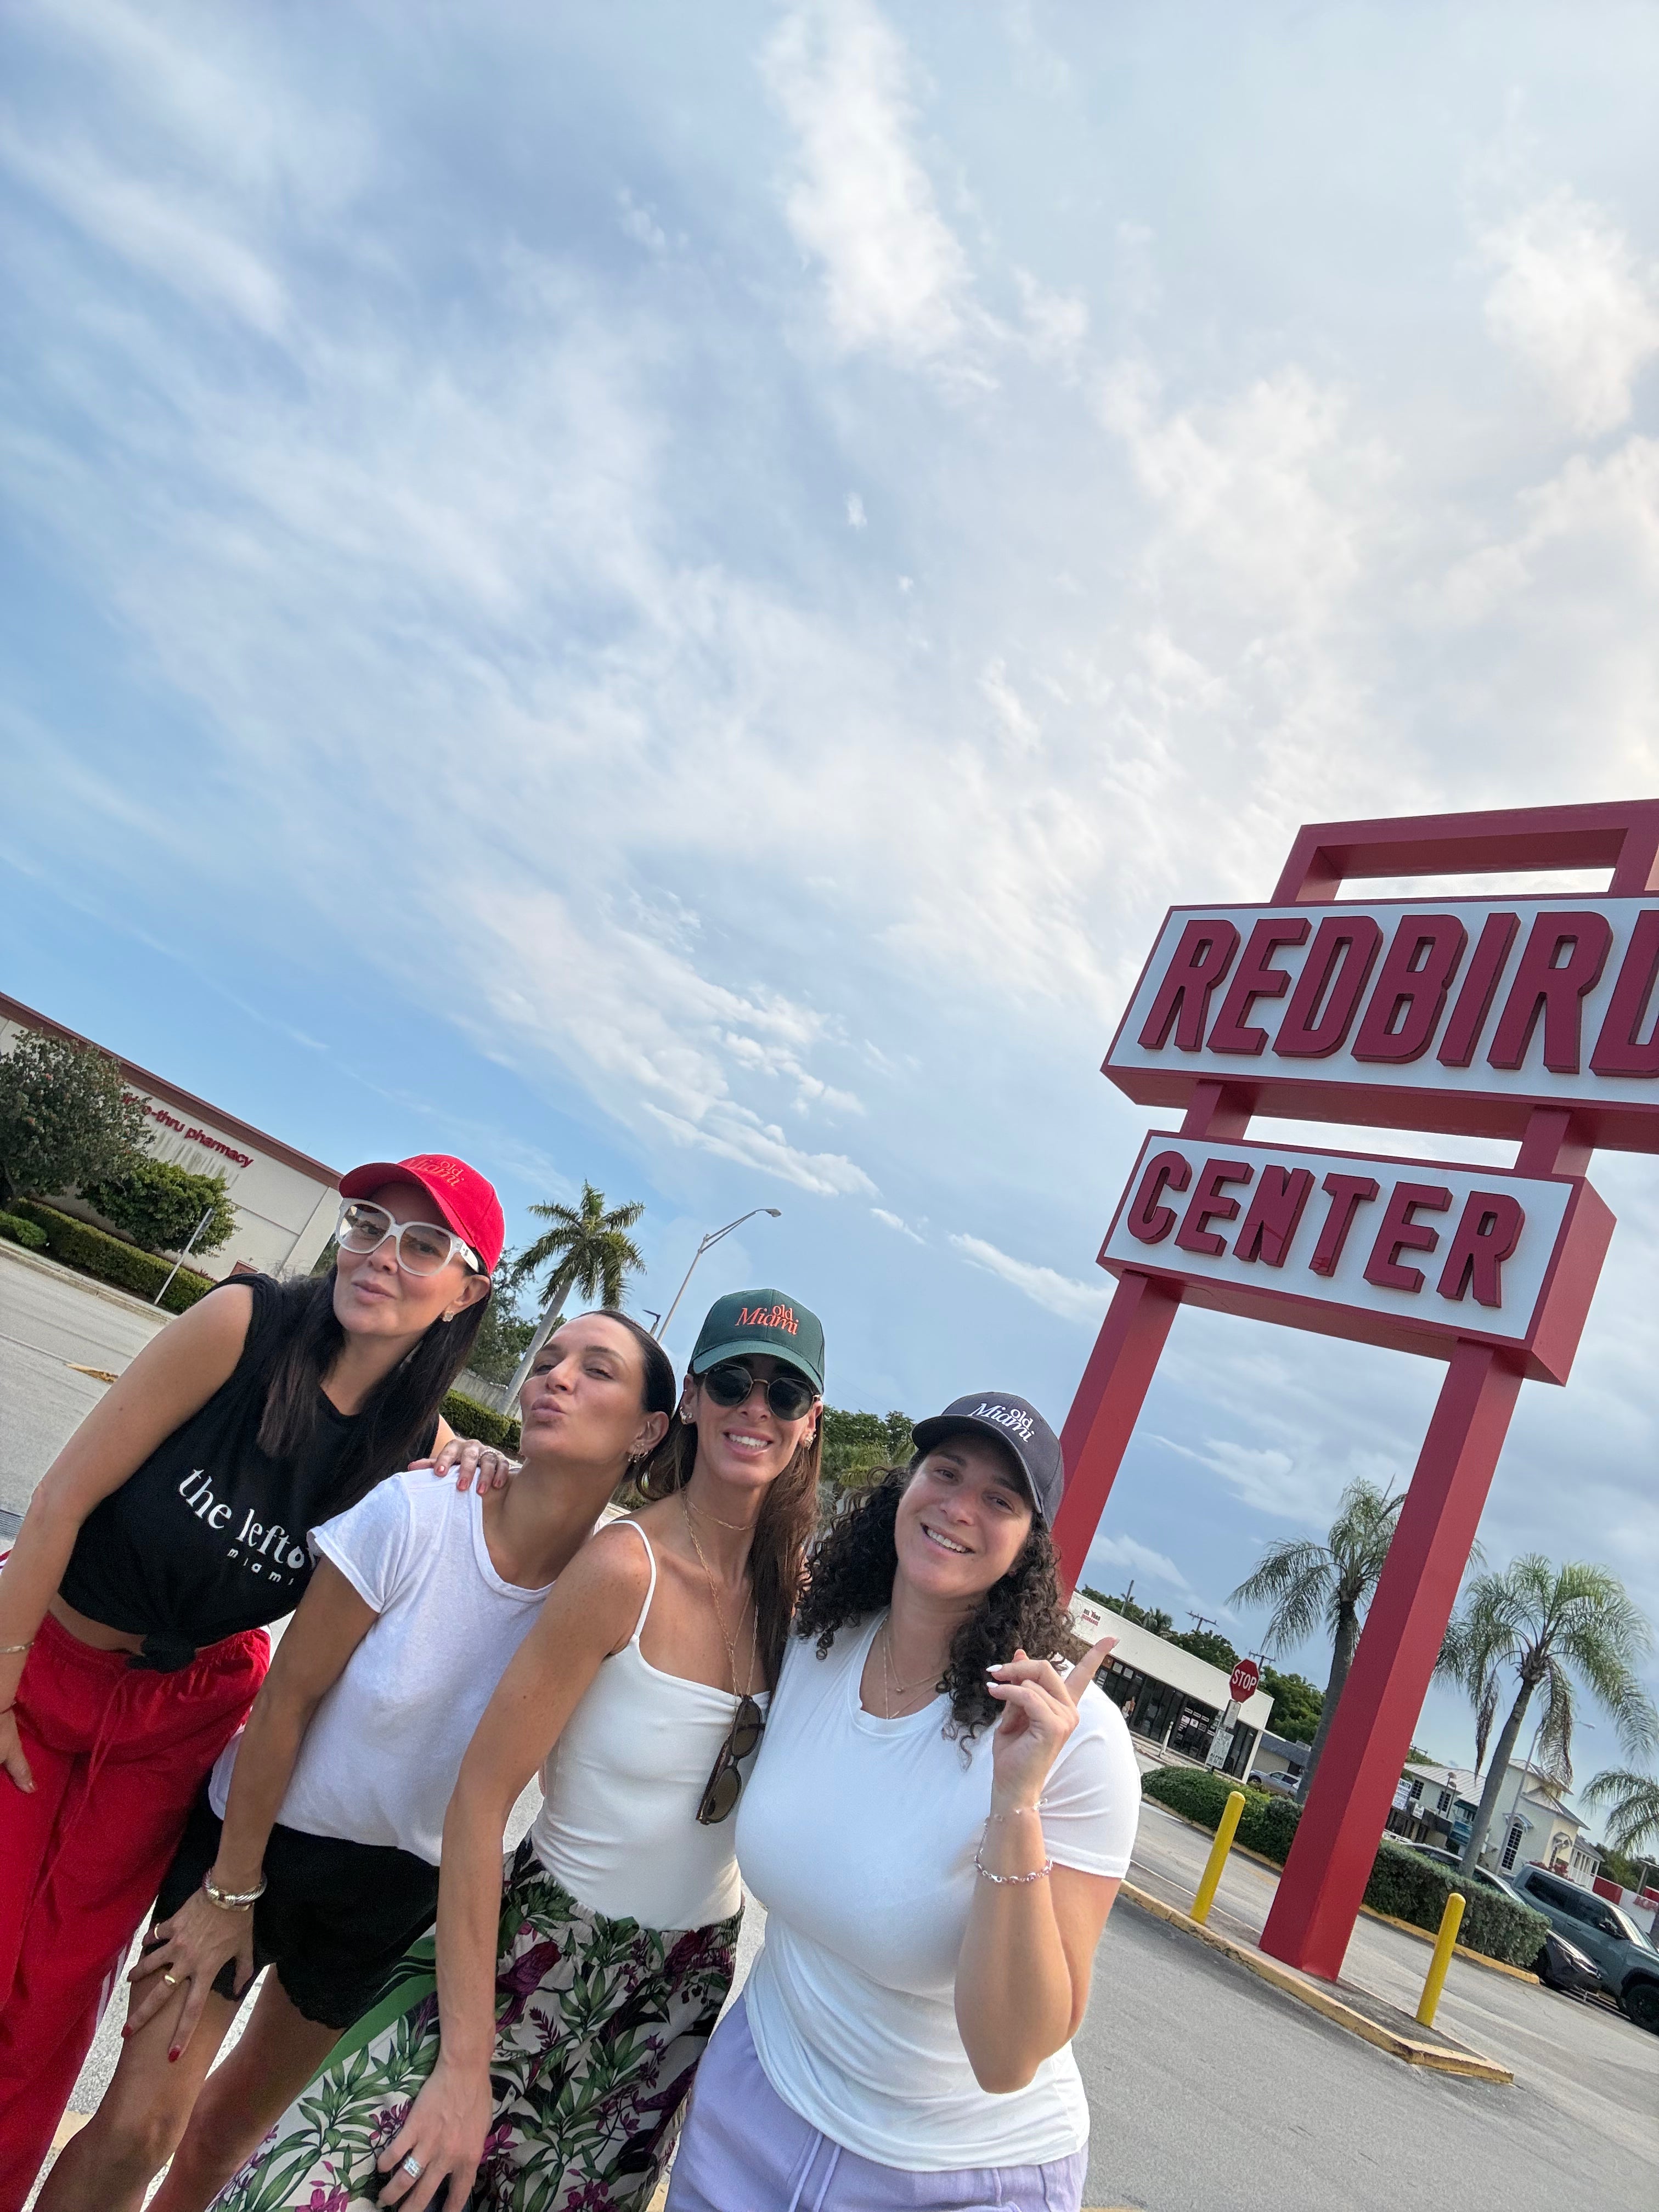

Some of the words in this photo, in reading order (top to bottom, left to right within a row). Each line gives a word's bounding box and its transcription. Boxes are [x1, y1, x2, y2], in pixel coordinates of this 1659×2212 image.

[184, 1127, 255, 1169] pharmacy
[1127, 1150, 1526, 1308] CENTER
[735, 1307, 799, 1335] Miami
[772, 1304, 794, 1322] old
[967, 1403, 1035, 1442] Miami
[1010, 1408, 1034, 1430] old
[178, 1469, 233, 1530] the
[1232, 1669, 1257, 1691] STOP
